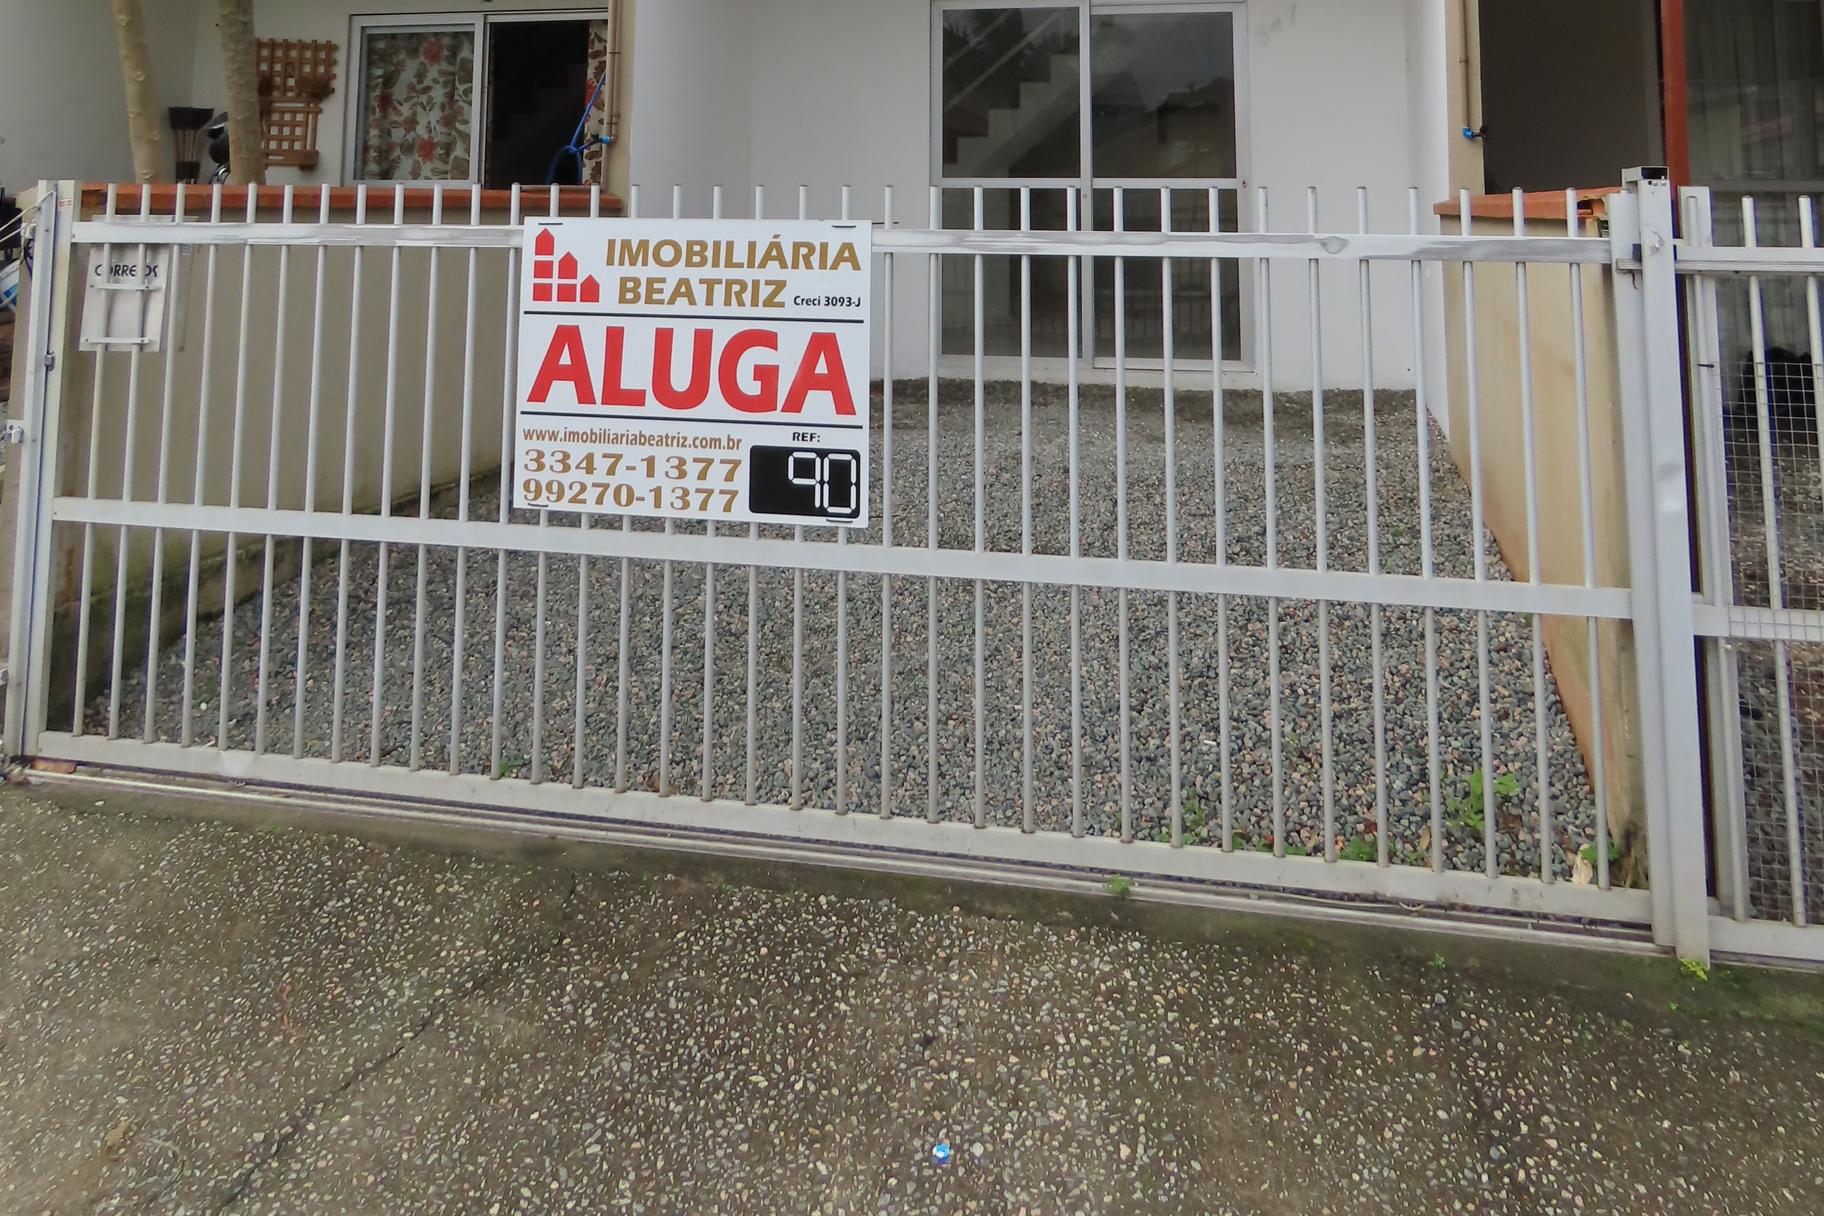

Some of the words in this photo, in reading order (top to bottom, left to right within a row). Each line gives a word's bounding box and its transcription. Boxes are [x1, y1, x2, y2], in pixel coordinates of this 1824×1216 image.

[605, 234, 862, 272] IMOBILIÁRIA
[617, 276, 788, 309] BEATRIZ
[793, 295, 821, 306] Creci
[823, 296, 862, 307] 3093-J
[526, 324, 857, 417] ALUGA
[522, 427, 743, 451] www.imobiliariabeatriz.com.br
[792, 431, 821, 443] REF:
[523, 448, 743, 483] 3347-1377
[787, 451, 857, 514] 90
[522, 477, 740, 513] 99270-1377
